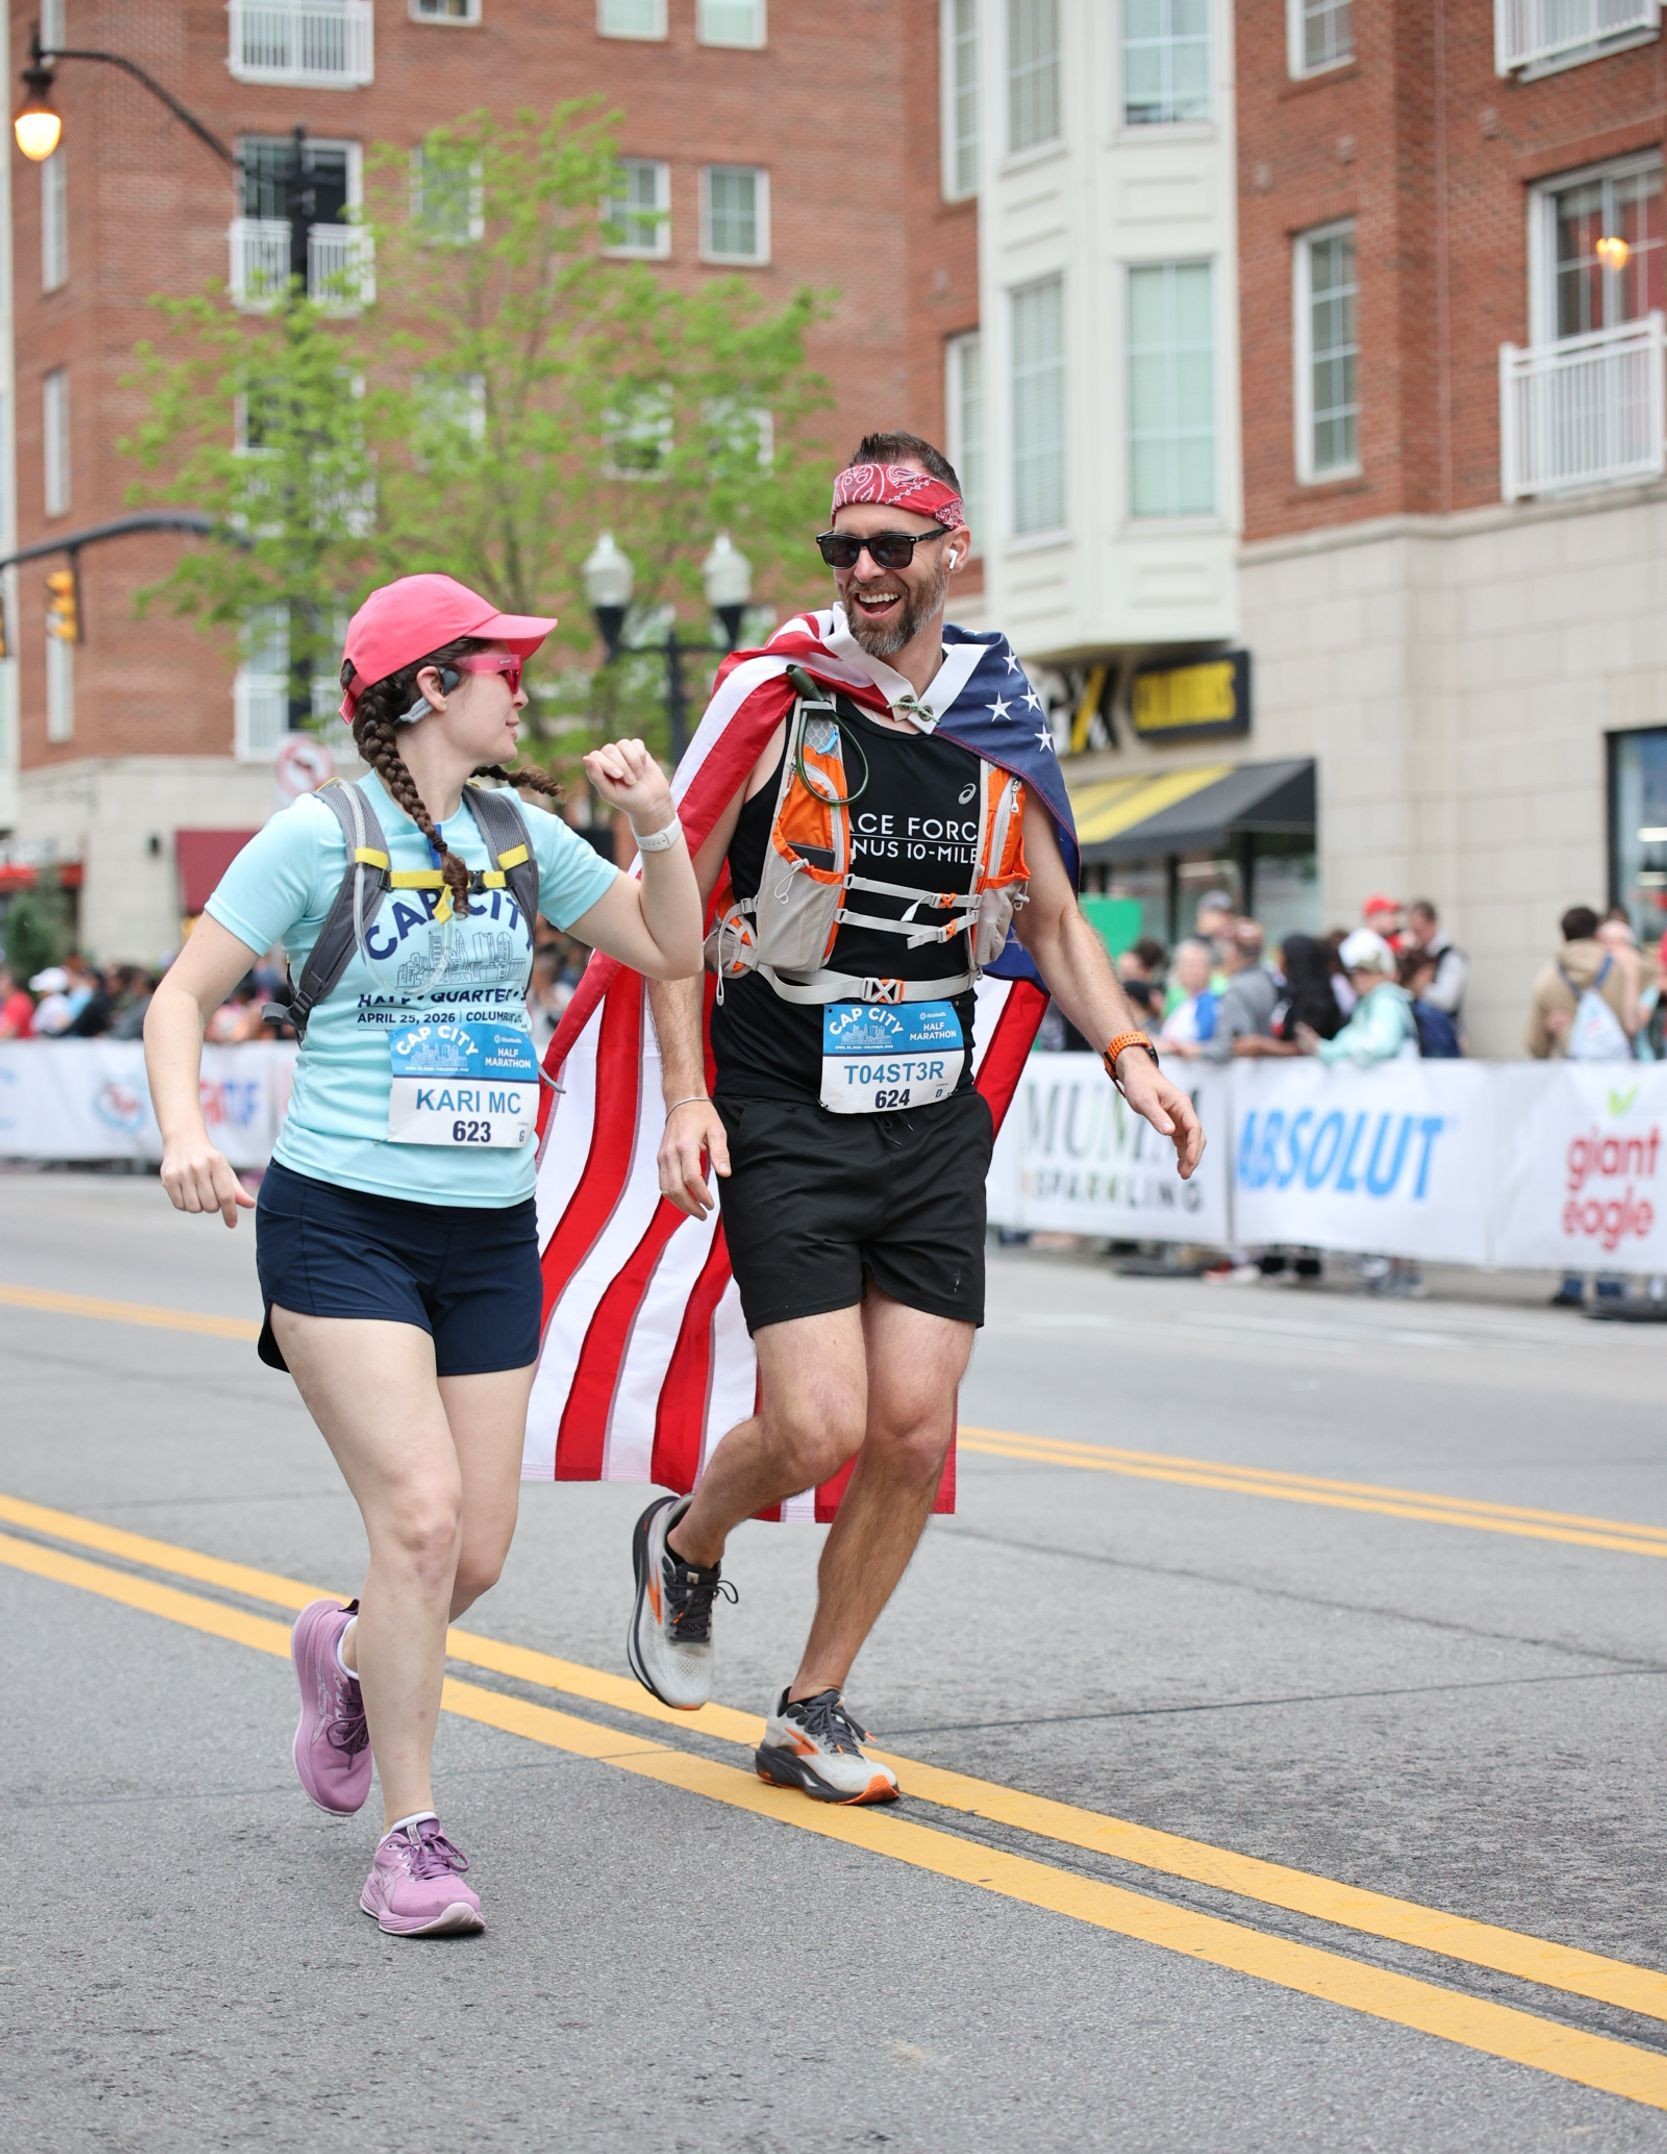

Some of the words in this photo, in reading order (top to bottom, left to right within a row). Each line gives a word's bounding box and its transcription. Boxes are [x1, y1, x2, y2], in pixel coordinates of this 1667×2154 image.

[850, 813, 894, 835] CE
[357, 1013, 396, 1024] APRIL
[400, 1014, 420, 1025] 25,
[423, 1012, 456, 1024] 2026
[829, 1007, 863, 1036] CAP
[868, 1007, 904, 1034] CITY
[923, 1021, 945, 1032] HALF
[396, 1026, 432, 1056] CAP
[437, 1025, 479, 1056] CITY
[909, 1030, 957, 1041] MARATHON
[485, 1057, 532, 1069] MARATHON
[497, 1047, 519, 1058] HALF
[416, 1088, 481, 1112] KARI
[489, 1091, 522, 1115] MC
[874, 1088, 911, 1109] 624
[452, 1120, 492, 1143] 623
[1238, 1108, 1446, 1202] ABSOLUT
[1566, 1122, 1660, 1194] giant
[1560, 1182, 1656, 1254] eagle
